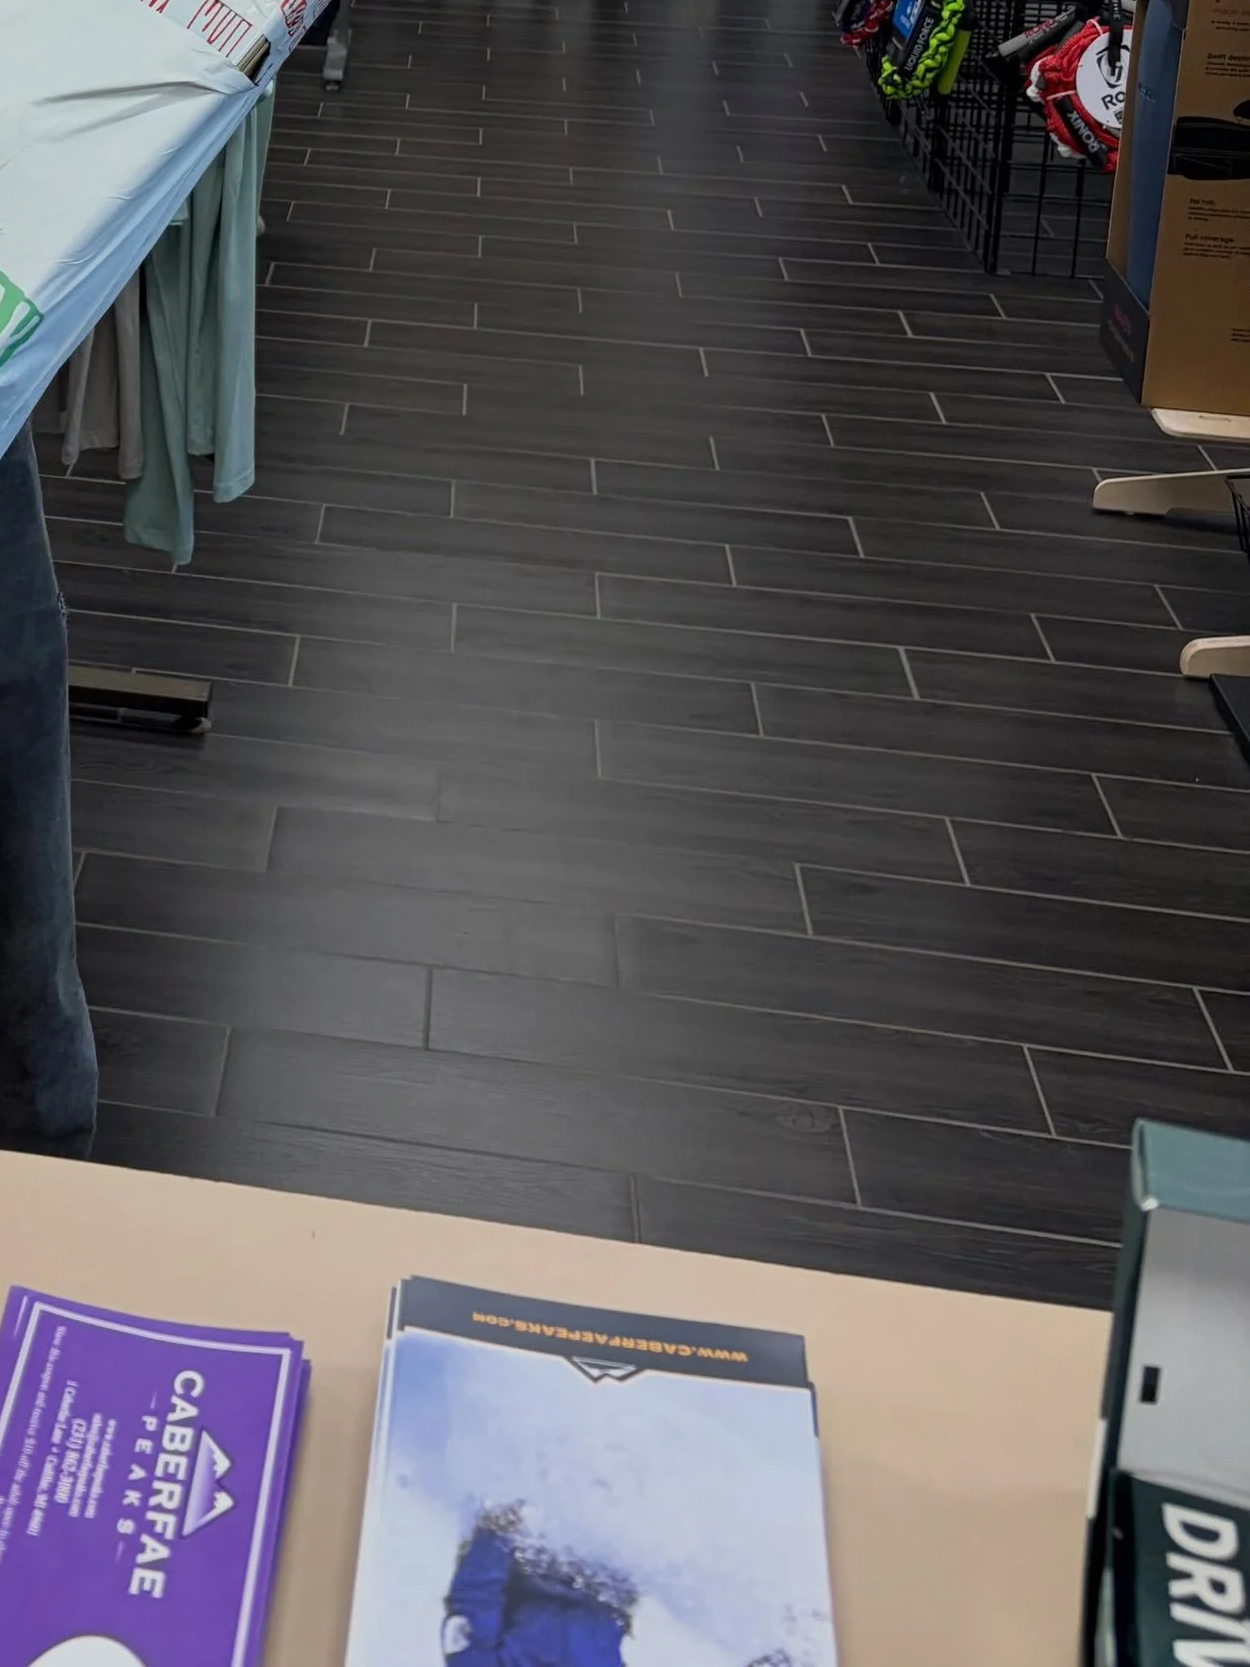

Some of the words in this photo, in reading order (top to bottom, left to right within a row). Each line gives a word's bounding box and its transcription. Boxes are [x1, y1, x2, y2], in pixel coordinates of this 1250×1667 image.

[472, 1311, 748, 1363] WWW.CABERFAEPEAKS.COM
[116, 1414, 159, 1537] PEAKS
[128, 1370, 205, 1599] CABERFAE
